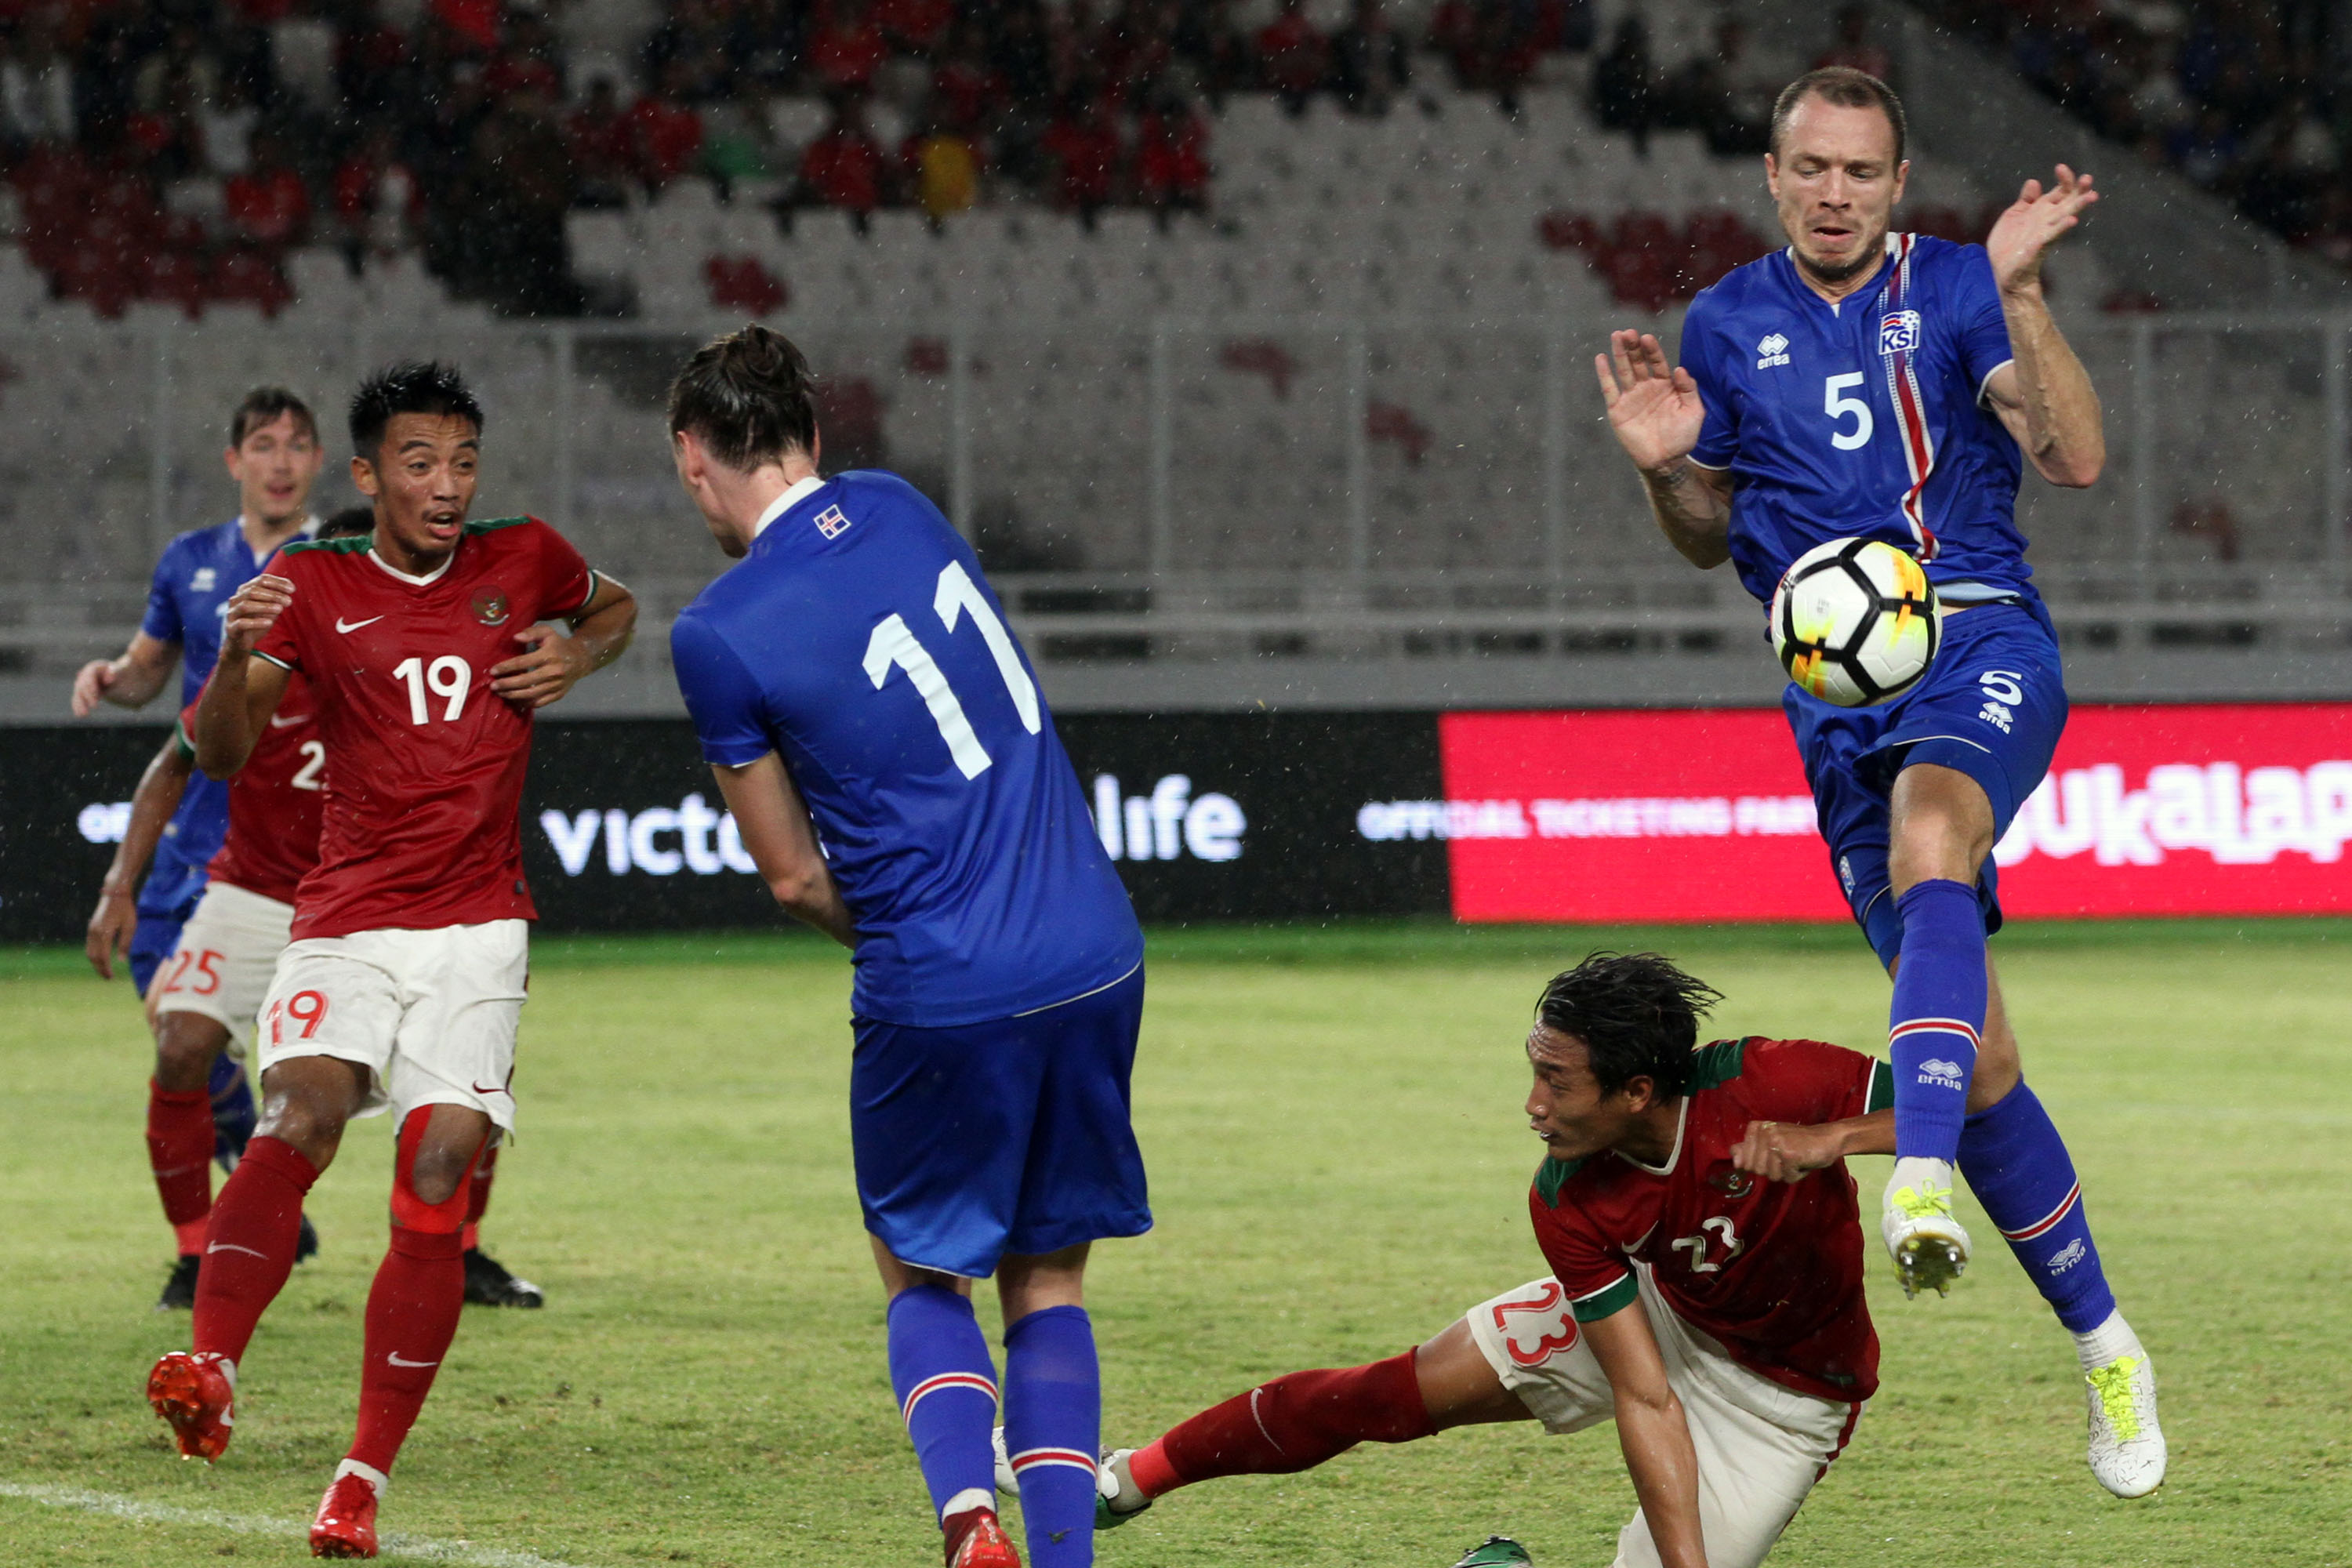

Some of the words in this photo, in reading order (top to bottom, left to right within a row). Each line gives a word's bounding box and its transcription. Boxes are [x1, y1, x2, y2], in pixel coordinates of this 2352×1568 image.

[1824, 371, 1874, 451] 5
[393, 655, 472, 726] 19
[862, 559, 1042, 782] 11
[1978, 670, 2023, 706] 5
[163, 949, 227, 997] 25
[266, 989, 330, 1047] 19
[1918, 1073, 1962, 1092] errea
[1492, 1282, 1579, 1368] 23
